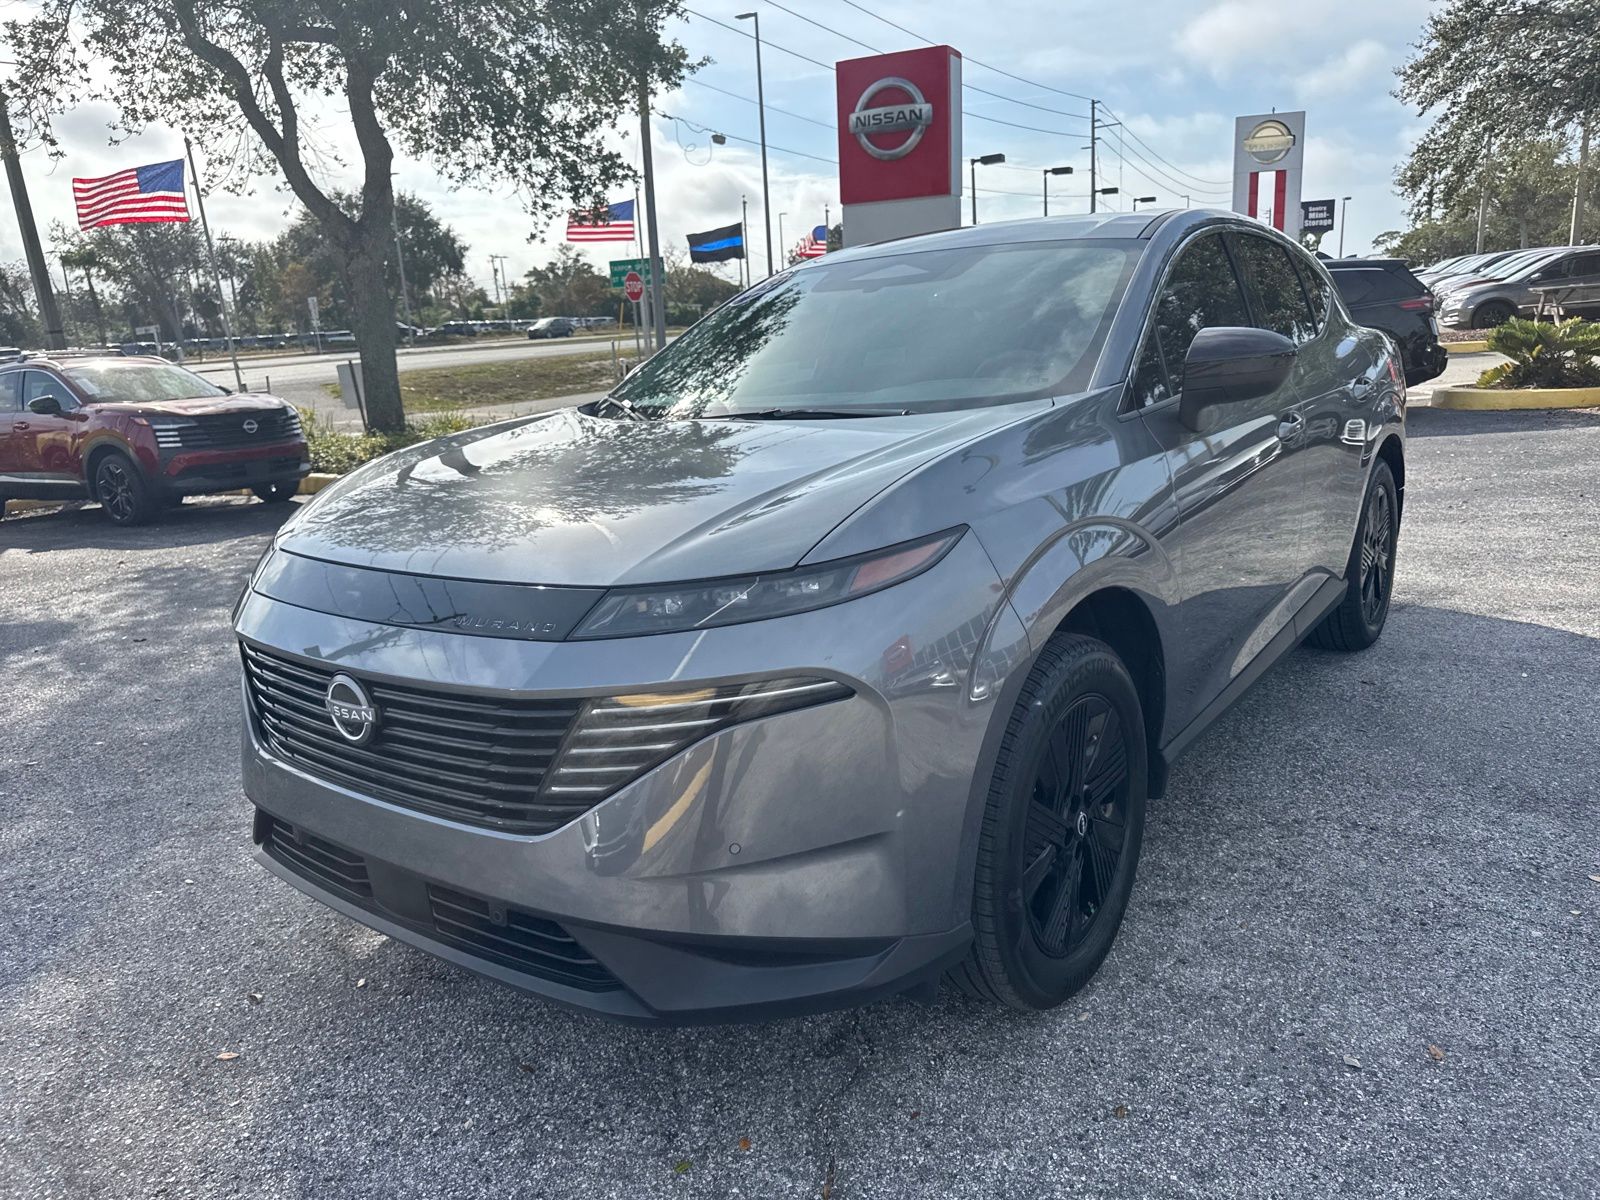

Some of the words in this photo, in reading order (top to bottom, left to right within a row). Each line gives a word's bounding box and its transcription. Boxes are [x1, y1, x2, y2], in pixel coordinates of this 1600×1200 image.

[855, 108, 923, 128] NISSAN
[1304, 219, 1332, 227] Storage
[626, 281, 643, 293] STOP
[456, 616, 556, 633] MURANO
